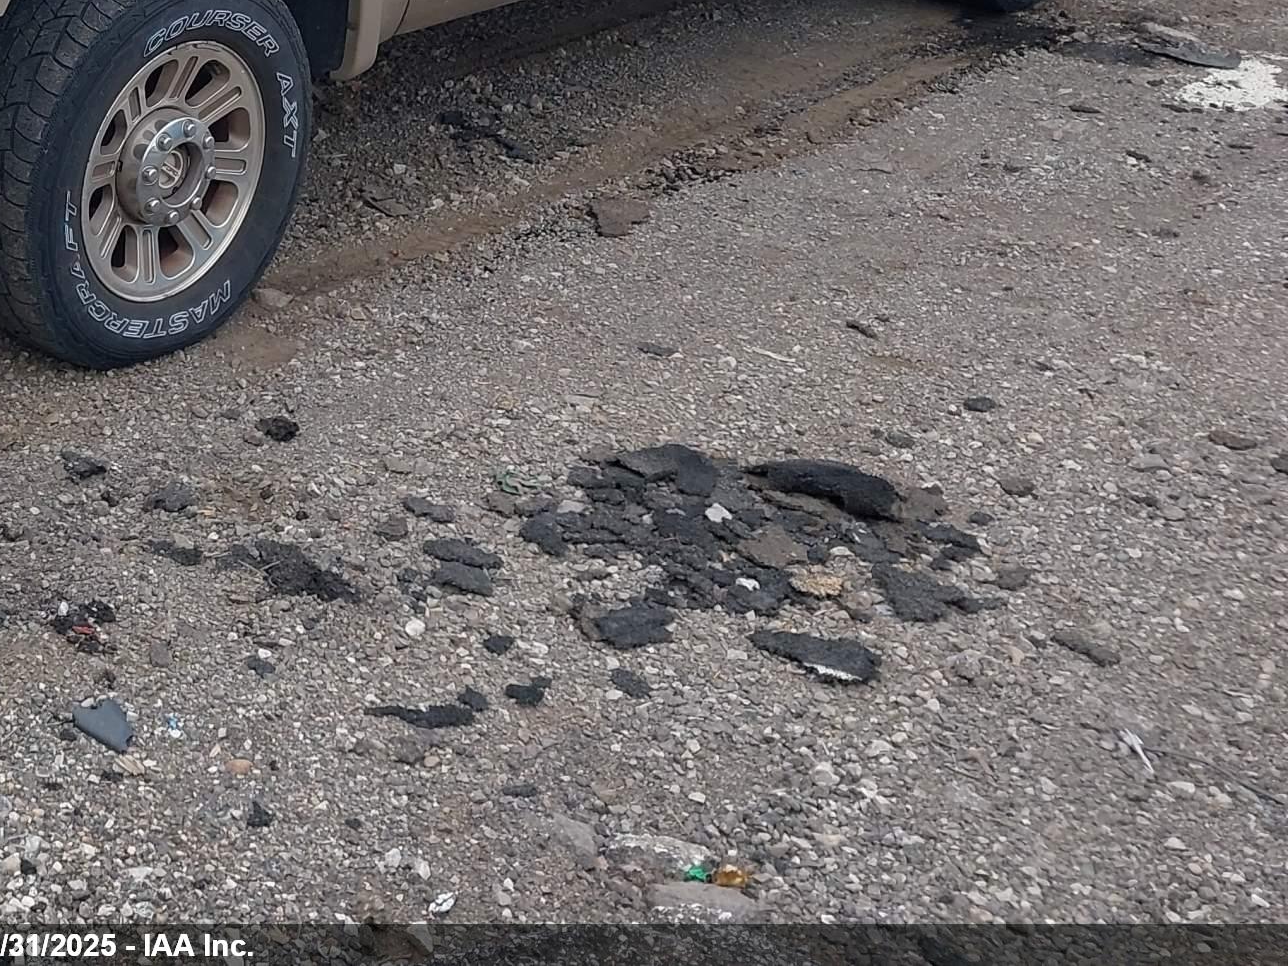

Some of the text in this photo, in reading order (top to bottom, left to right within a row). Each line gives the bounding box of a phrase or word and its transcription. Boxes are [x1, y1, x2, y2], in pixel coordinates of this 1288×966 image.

[144, 9, 300, 159] COURSER AXT
[64, 190, 232, 340] MASTERCRAFT
